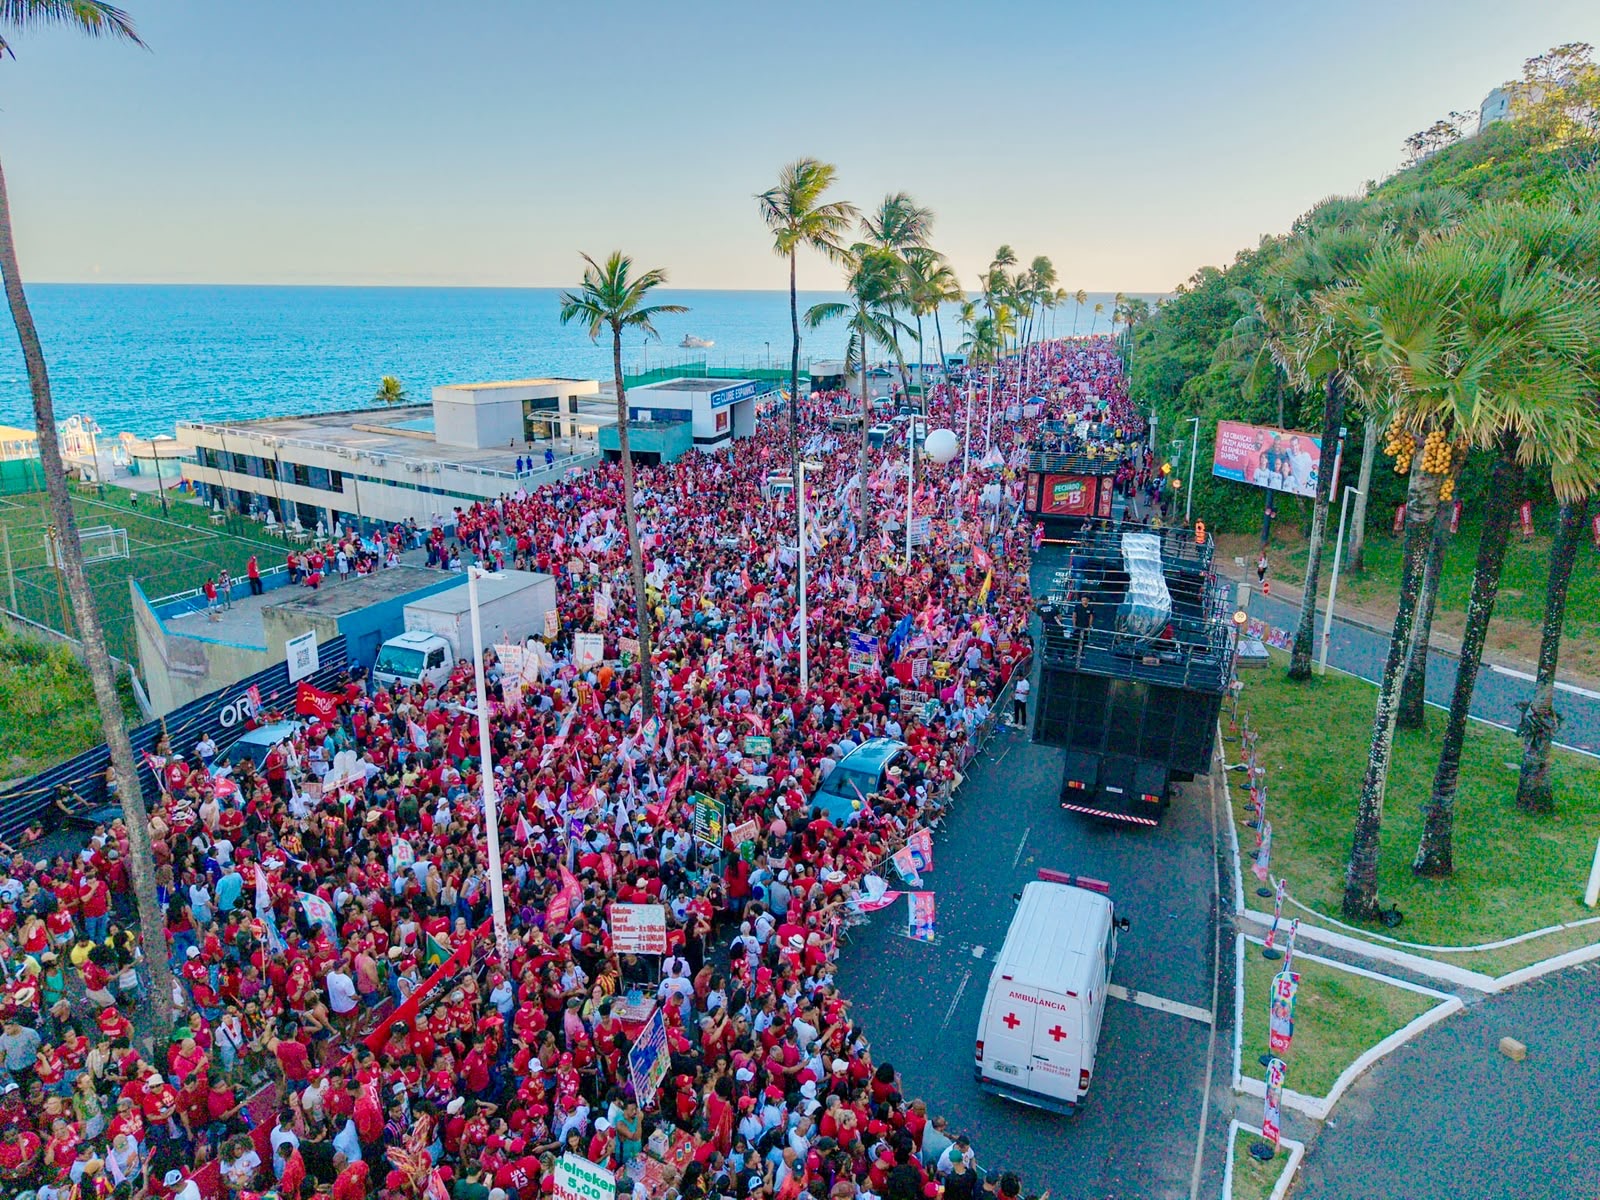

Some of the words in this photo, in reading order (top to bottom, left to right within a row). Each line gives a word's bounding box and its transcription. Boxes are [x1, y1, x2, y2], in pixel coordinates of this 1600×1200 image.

[1222, 438, 1237, 447] FAZEM
[1054, 482, 1080, 492] FECHADO
[1069, 490, 1082, 504] 13
[1278, 980, 1292, 998] 13
[512, 1176, 528, 1190] 13
[568, 1177, 600, 1200] 5,00
